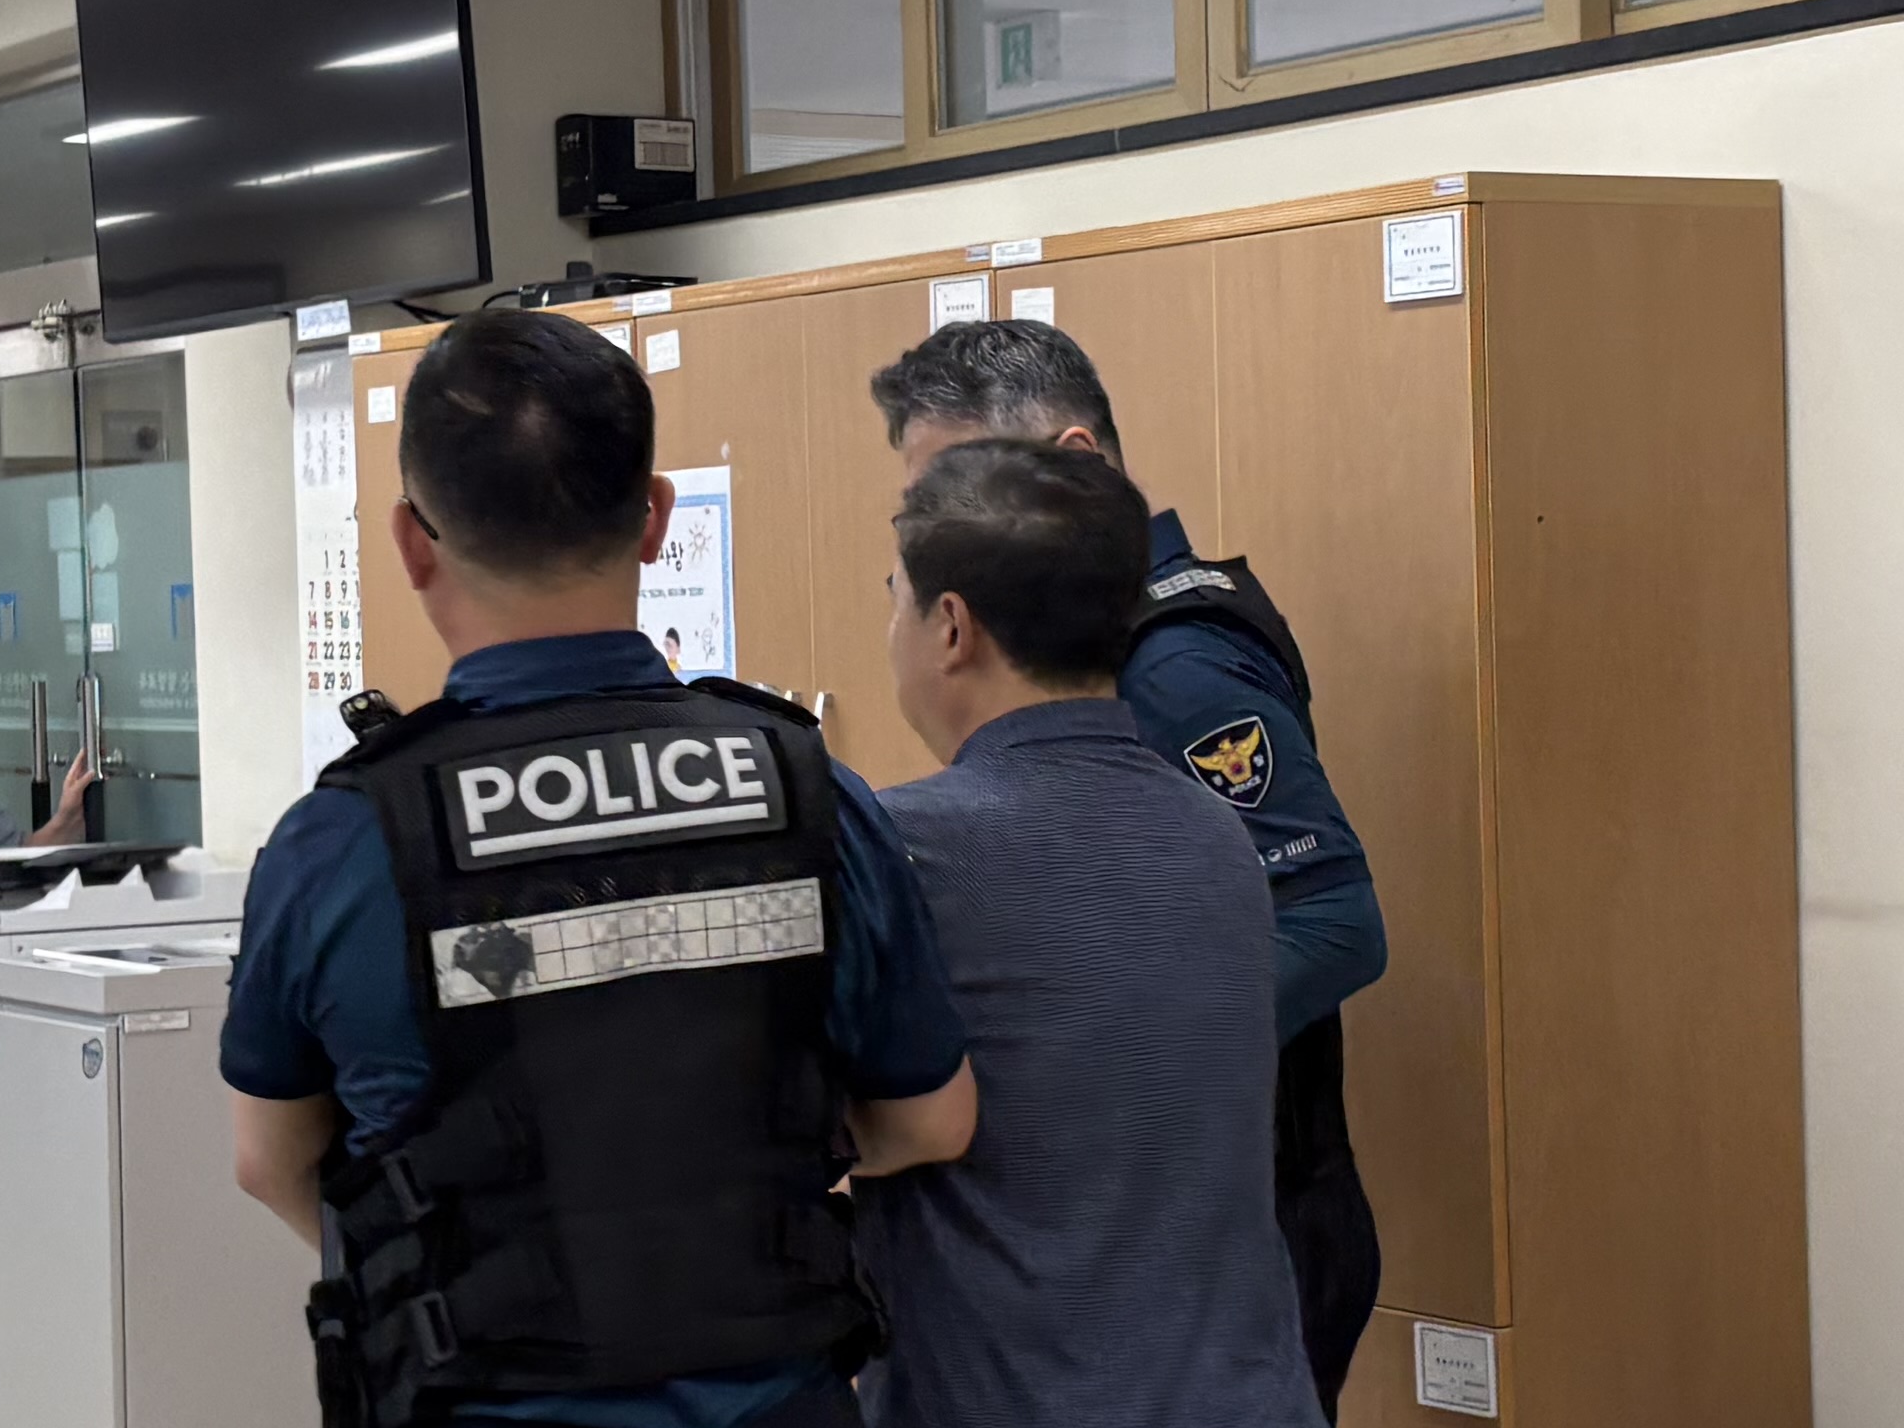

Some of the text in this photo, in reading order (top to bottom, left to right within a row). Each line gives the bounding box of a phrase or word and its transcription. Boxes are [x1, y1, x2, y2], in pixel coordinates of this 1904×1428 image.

[324, 581, 331, 600] 8
[340, 580, 347, 600] 9
[308, 611, 317, 630] 14
[340, 610, 349, 630] 16
[308, 641, 317, 661] 21
[323, 641, 334, 660] 22
[339, 641, 350, 661] 23
[308, 671, 351, 691] 28 29 30
[457, 736, 767, 834] POLICE
